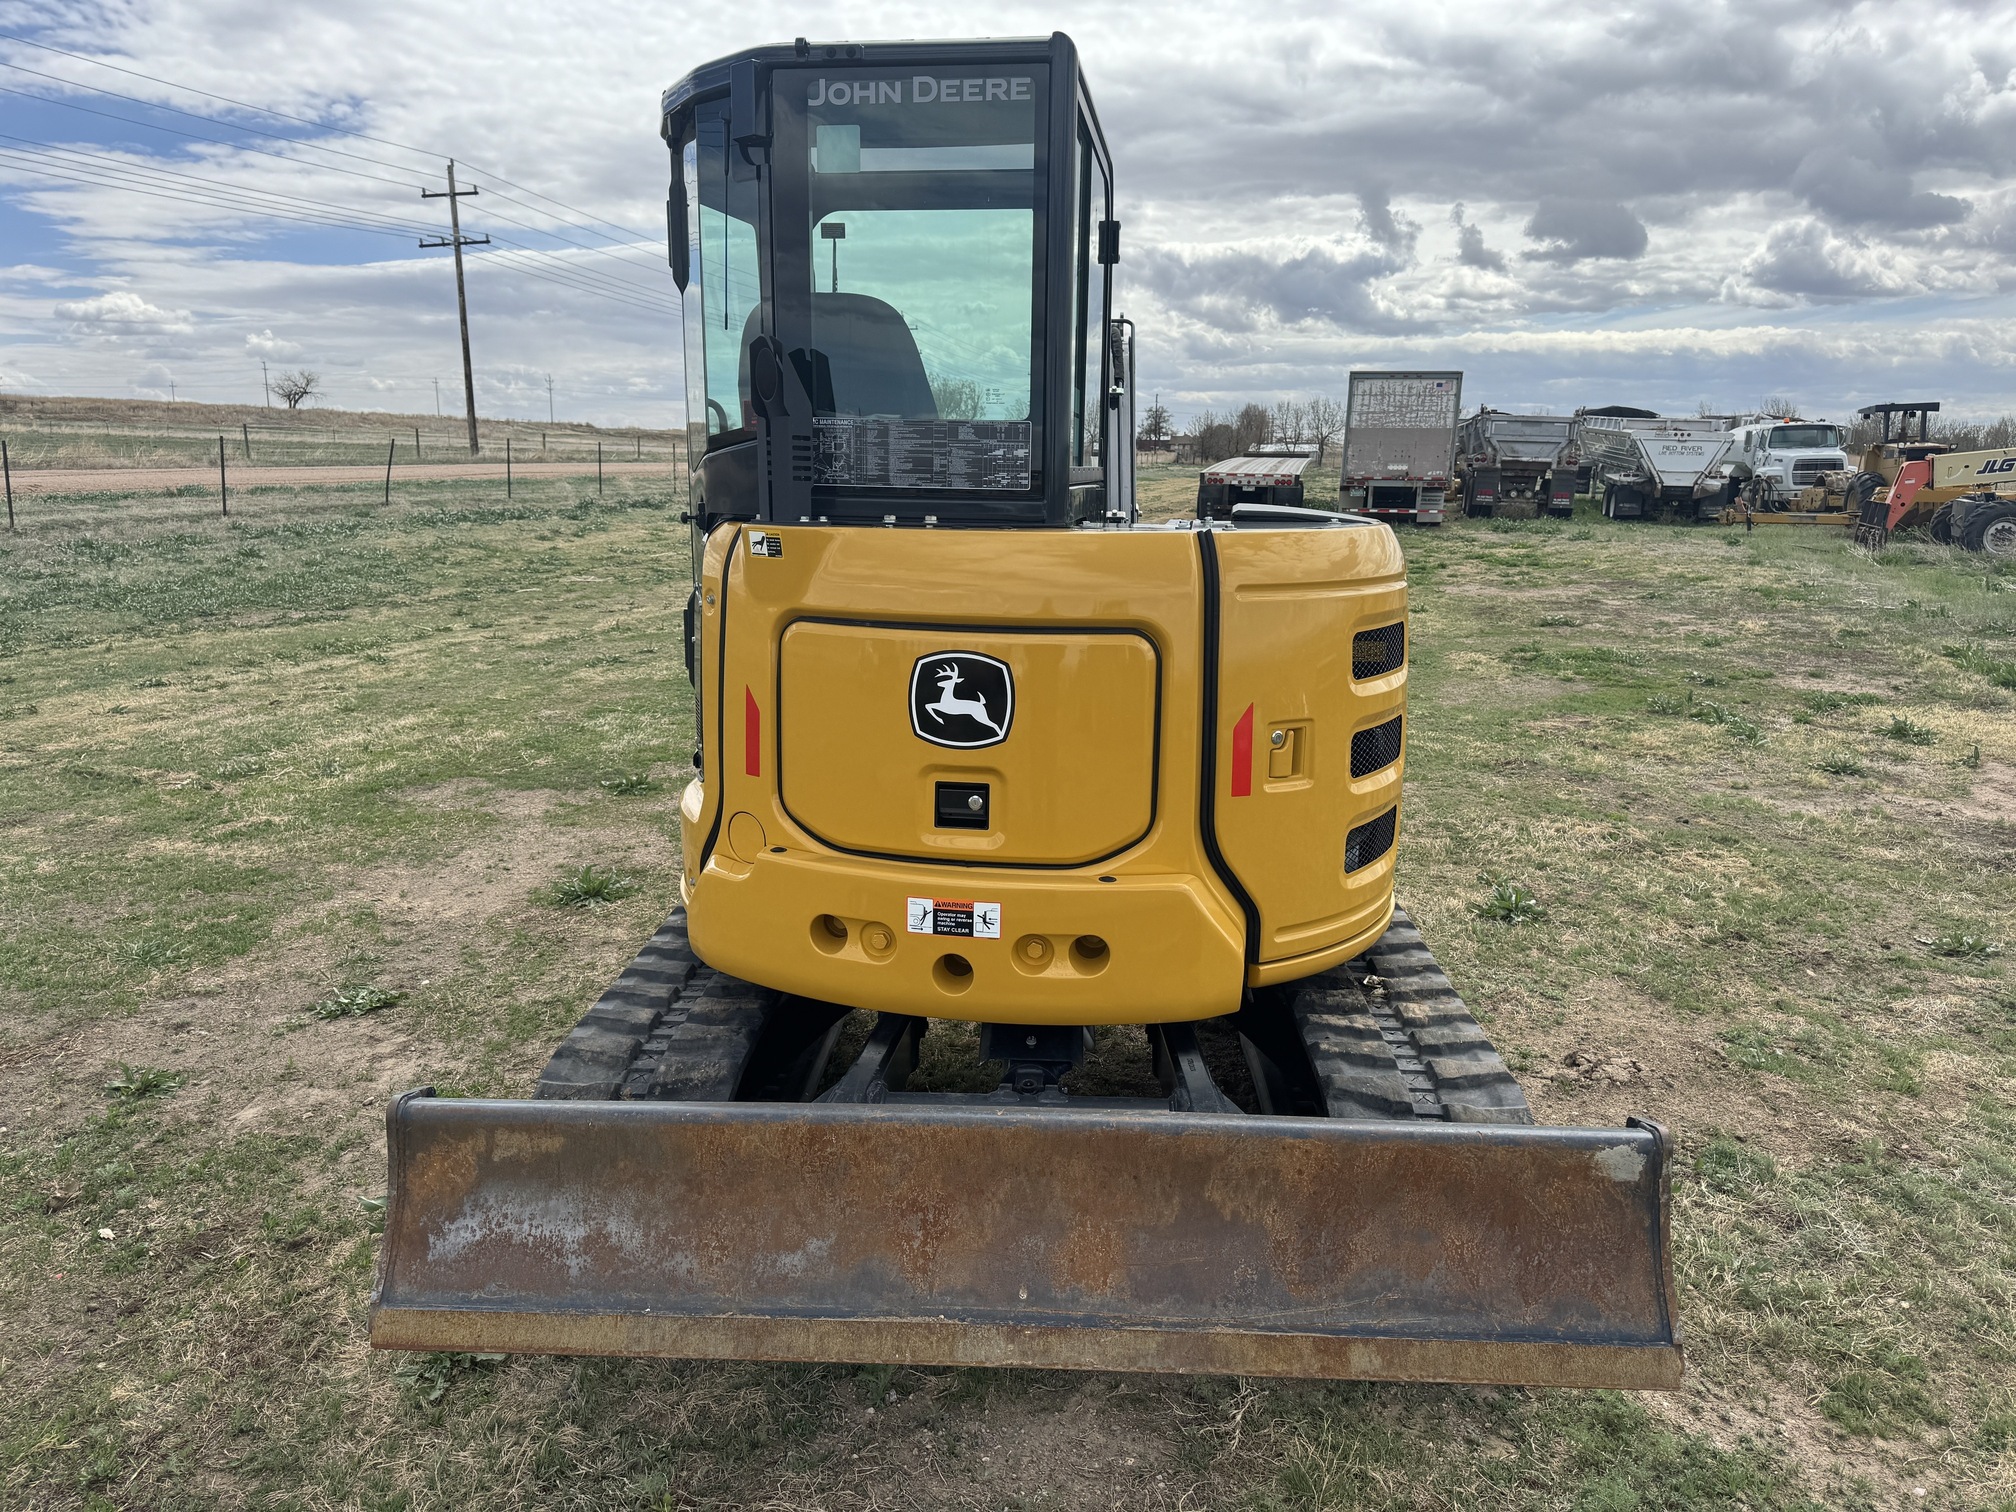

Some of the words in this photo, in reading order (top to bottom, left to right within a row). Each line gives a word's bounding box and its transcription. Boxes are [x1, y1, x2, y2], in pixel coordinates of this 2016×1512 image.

[808, 78, 902, 106] JOHN
[912, 75, 1031, 103] DEERE
[1975, 457, 2016, 475] JLG
[941, 902, 973, 910] WARNING
